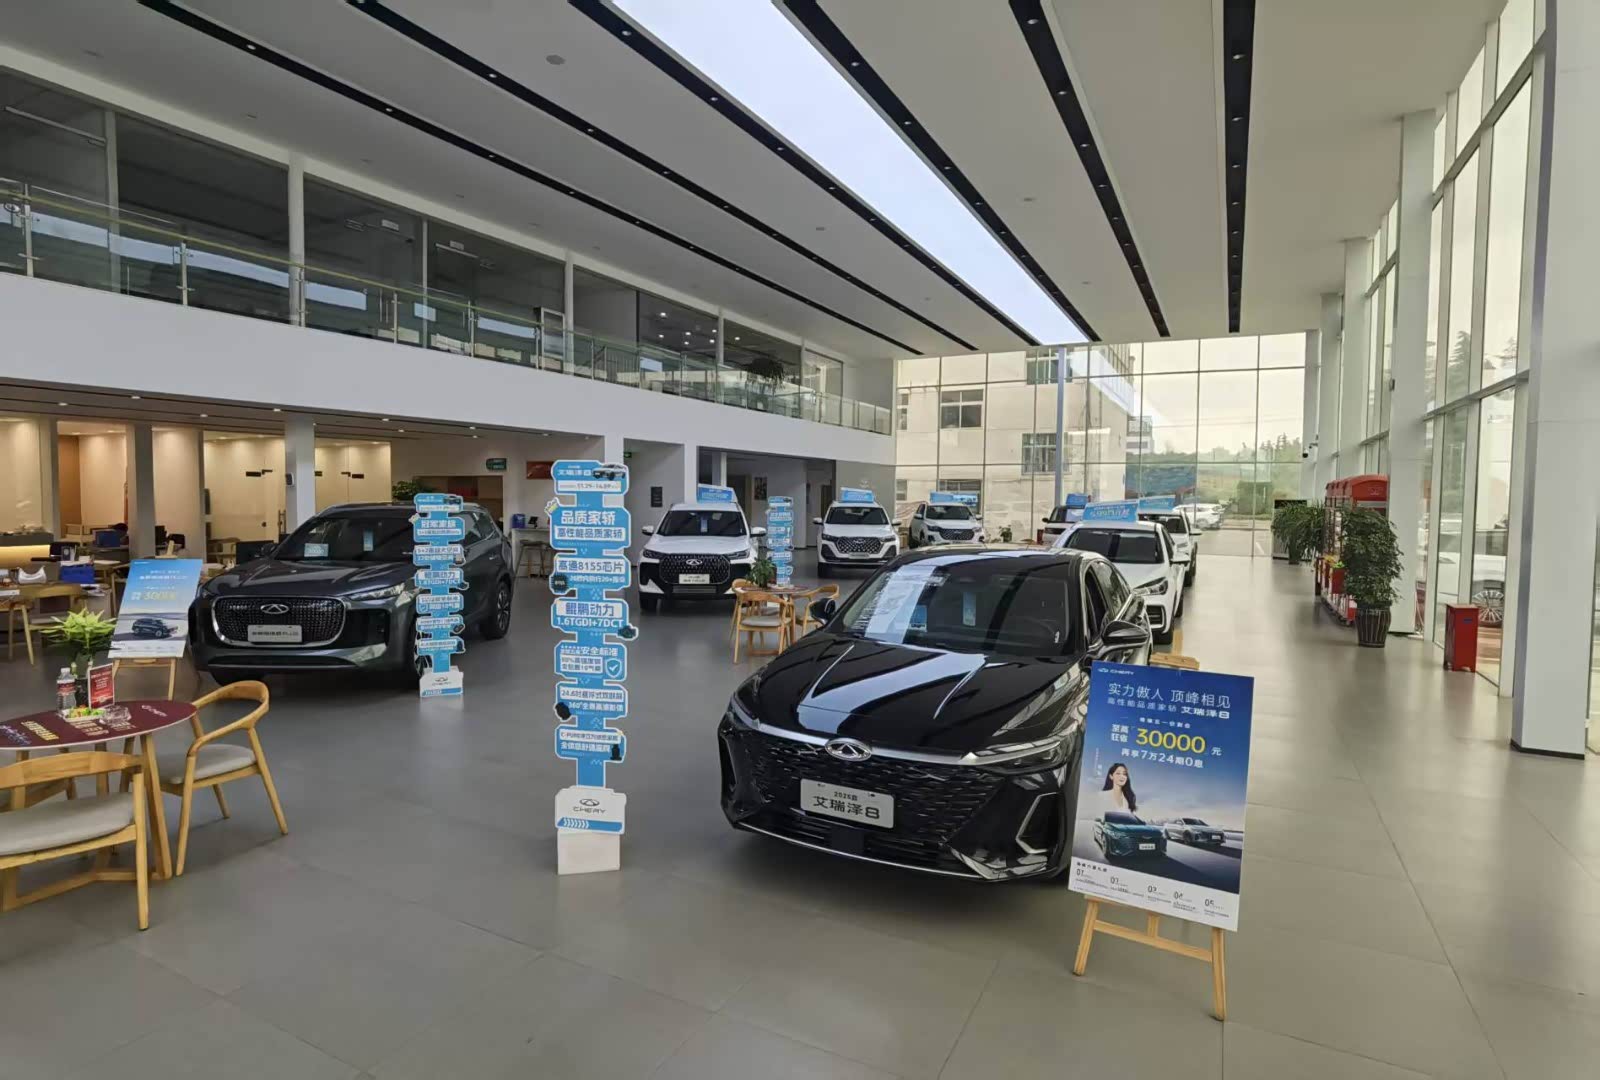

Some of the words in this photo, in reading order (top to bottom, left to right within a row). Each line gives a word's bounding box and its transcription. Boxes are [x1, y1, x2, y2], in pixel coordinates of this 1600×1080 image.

[561, 510, 616, 526] 品质家轿
[557, 527, 623, 539] 高性能品质家轿
[558, 560, 624, 573] 高通8155芯片
[565, 602, 615, 617] 鲲鹏动力
[557, 617, 624, 627] 1.6TGDI+7DCT
[1108, 683, 1164, 701] 实力傲人
[1170, 689, 1231, 709] 顶峰相见
[1181, 706, 1230, 719] 艾瑞泽8
[1135, 728, 1206, 754] 30000
[1211, 747, 1222, 756] 元
[573, 806, 606, 814] CHERY
[813, 796, 880, 819] 艾瑞泽8
